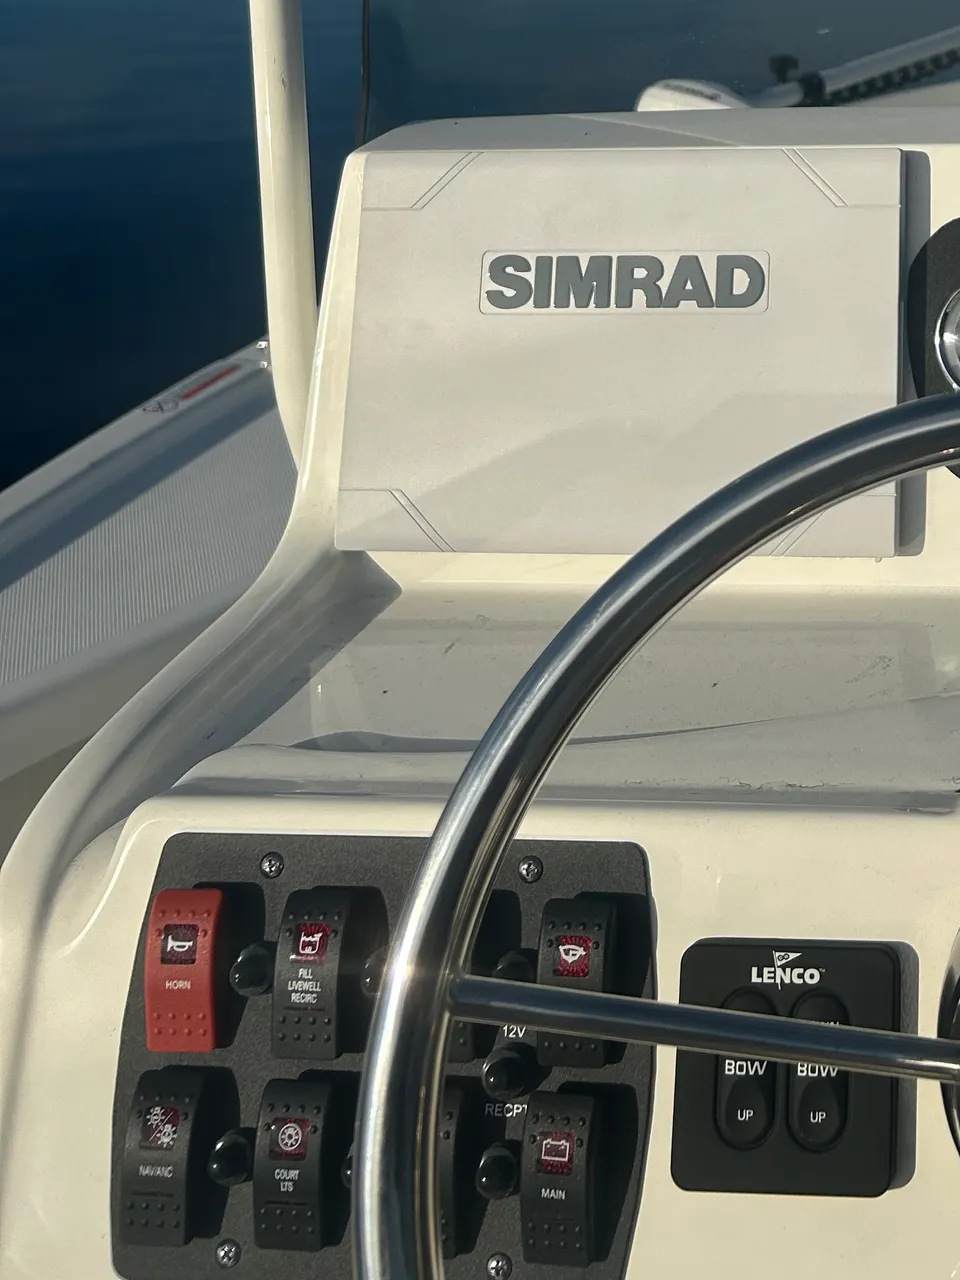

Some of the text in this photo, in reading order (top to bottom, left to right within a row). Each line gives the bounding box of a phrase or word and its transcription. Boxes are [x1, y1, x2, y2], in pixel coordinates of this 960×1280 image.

[486, 254, 766, 310] SIMRAD
[298, 968, 313, 979] FILL
[751, 967, 821, 984] LENCO
[165, 980, 191, 991] HORN
[287, 980, 321, 992] LIVEWELL
[291, 992, 318, 1004] RECIRC
[502, 1024, 527, 1038] 12V
[724, 1060, 768, 1076] BOW
[797, 1062, 840, 1078] BOW
[737, 1109, 754, 1121] UP
[810, 1111, 826, 1123] UP
[274, 1169, 300, 1181] COURT
[280, 1182, 294, 1192] LTS
[541, 1188, 566, 1200] MAIN
